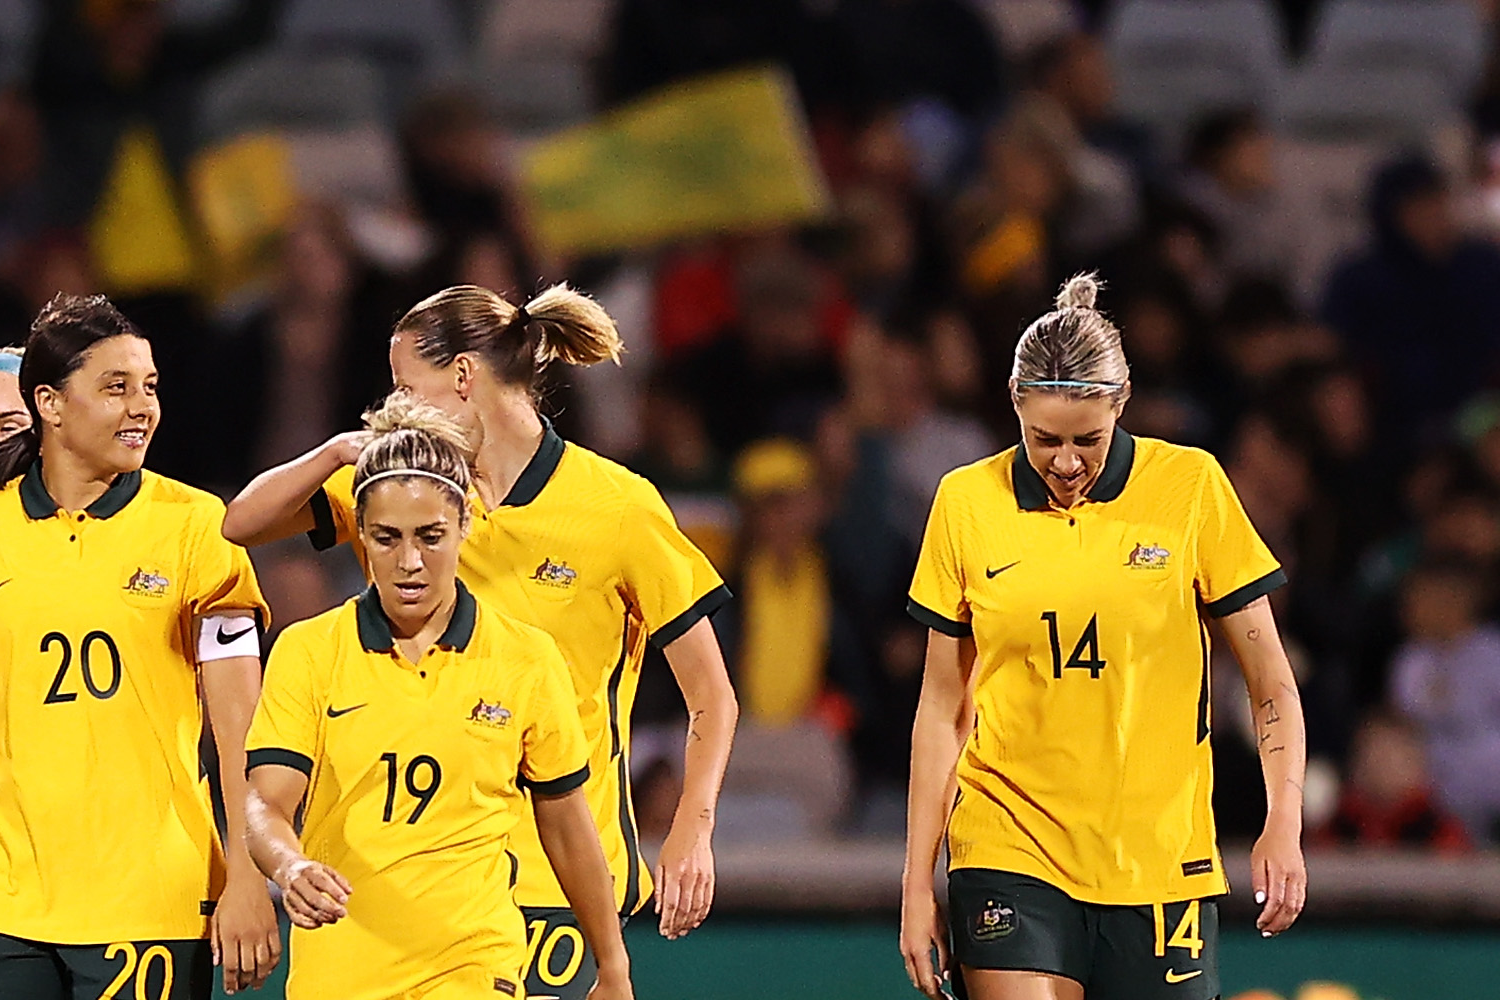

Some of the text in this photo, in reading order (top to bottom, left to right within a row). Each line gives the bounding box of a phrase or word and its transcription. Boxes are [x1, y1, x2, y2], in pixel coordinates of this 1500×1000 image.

[39, 630, 120, 704] 20
[1040, 612, 1106, 679] 14
[379, 753, 441, 825] 19
[519, 919, 585, 986] 10
[1153, 901, 1203, 958] 14
